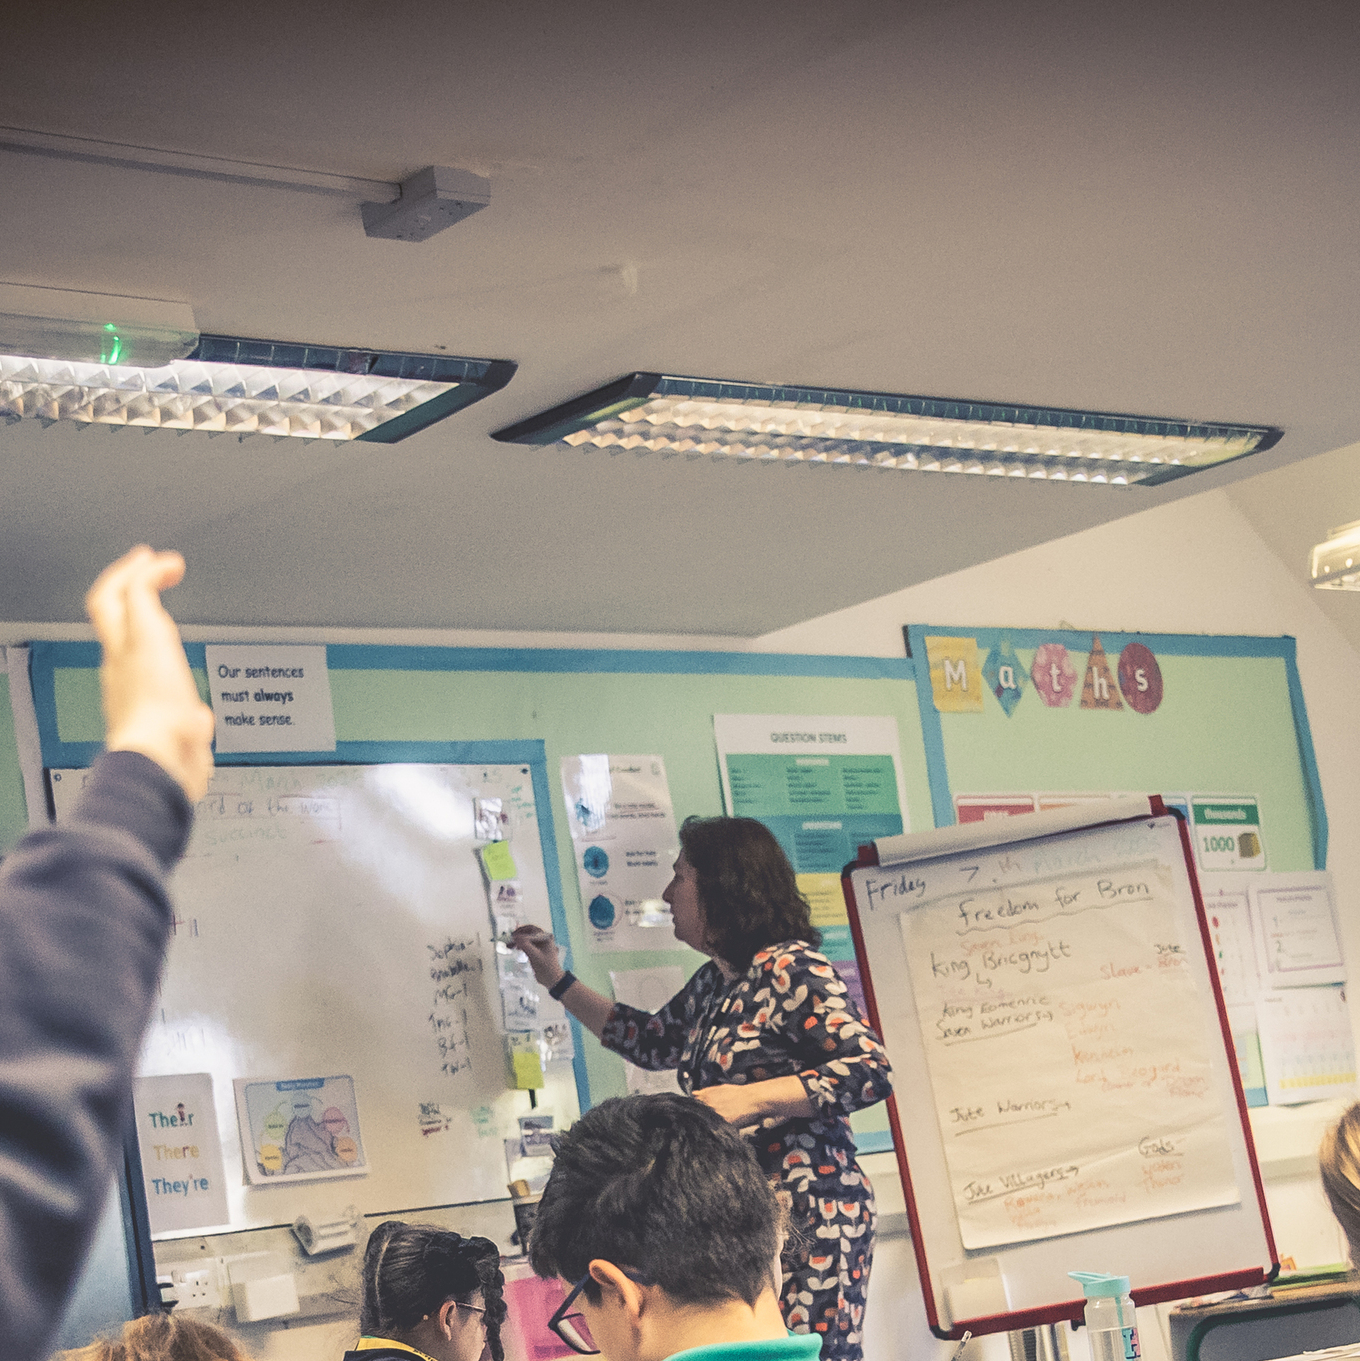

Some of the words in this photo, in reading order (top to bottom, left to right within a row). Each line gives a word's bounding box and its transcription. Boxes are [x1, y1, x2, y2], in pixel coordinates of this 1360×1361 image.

[218, 664, 241, 678] Our
[245, 666, 304, 679] sentences
[943, 659, 1149, 700] Maths
[221, 690, 249, 702] must
[254, 688, 294, 704] always
[224, 712, 255, 726] make
[259, 715, 296, 726] sense.
[770, 733, 817, 744] QUESTION
[818, 733, 847, 744] STEMS
[1203, 836, 1235, 852] 1000
[866, 877, 926, 911] Friday
[1055, 886, 1081, 909] for
[1097, 878, 1150, 898] Bron
[153, 1144, 200, 1161] There
[152, 1174, 209, 1196] They're
